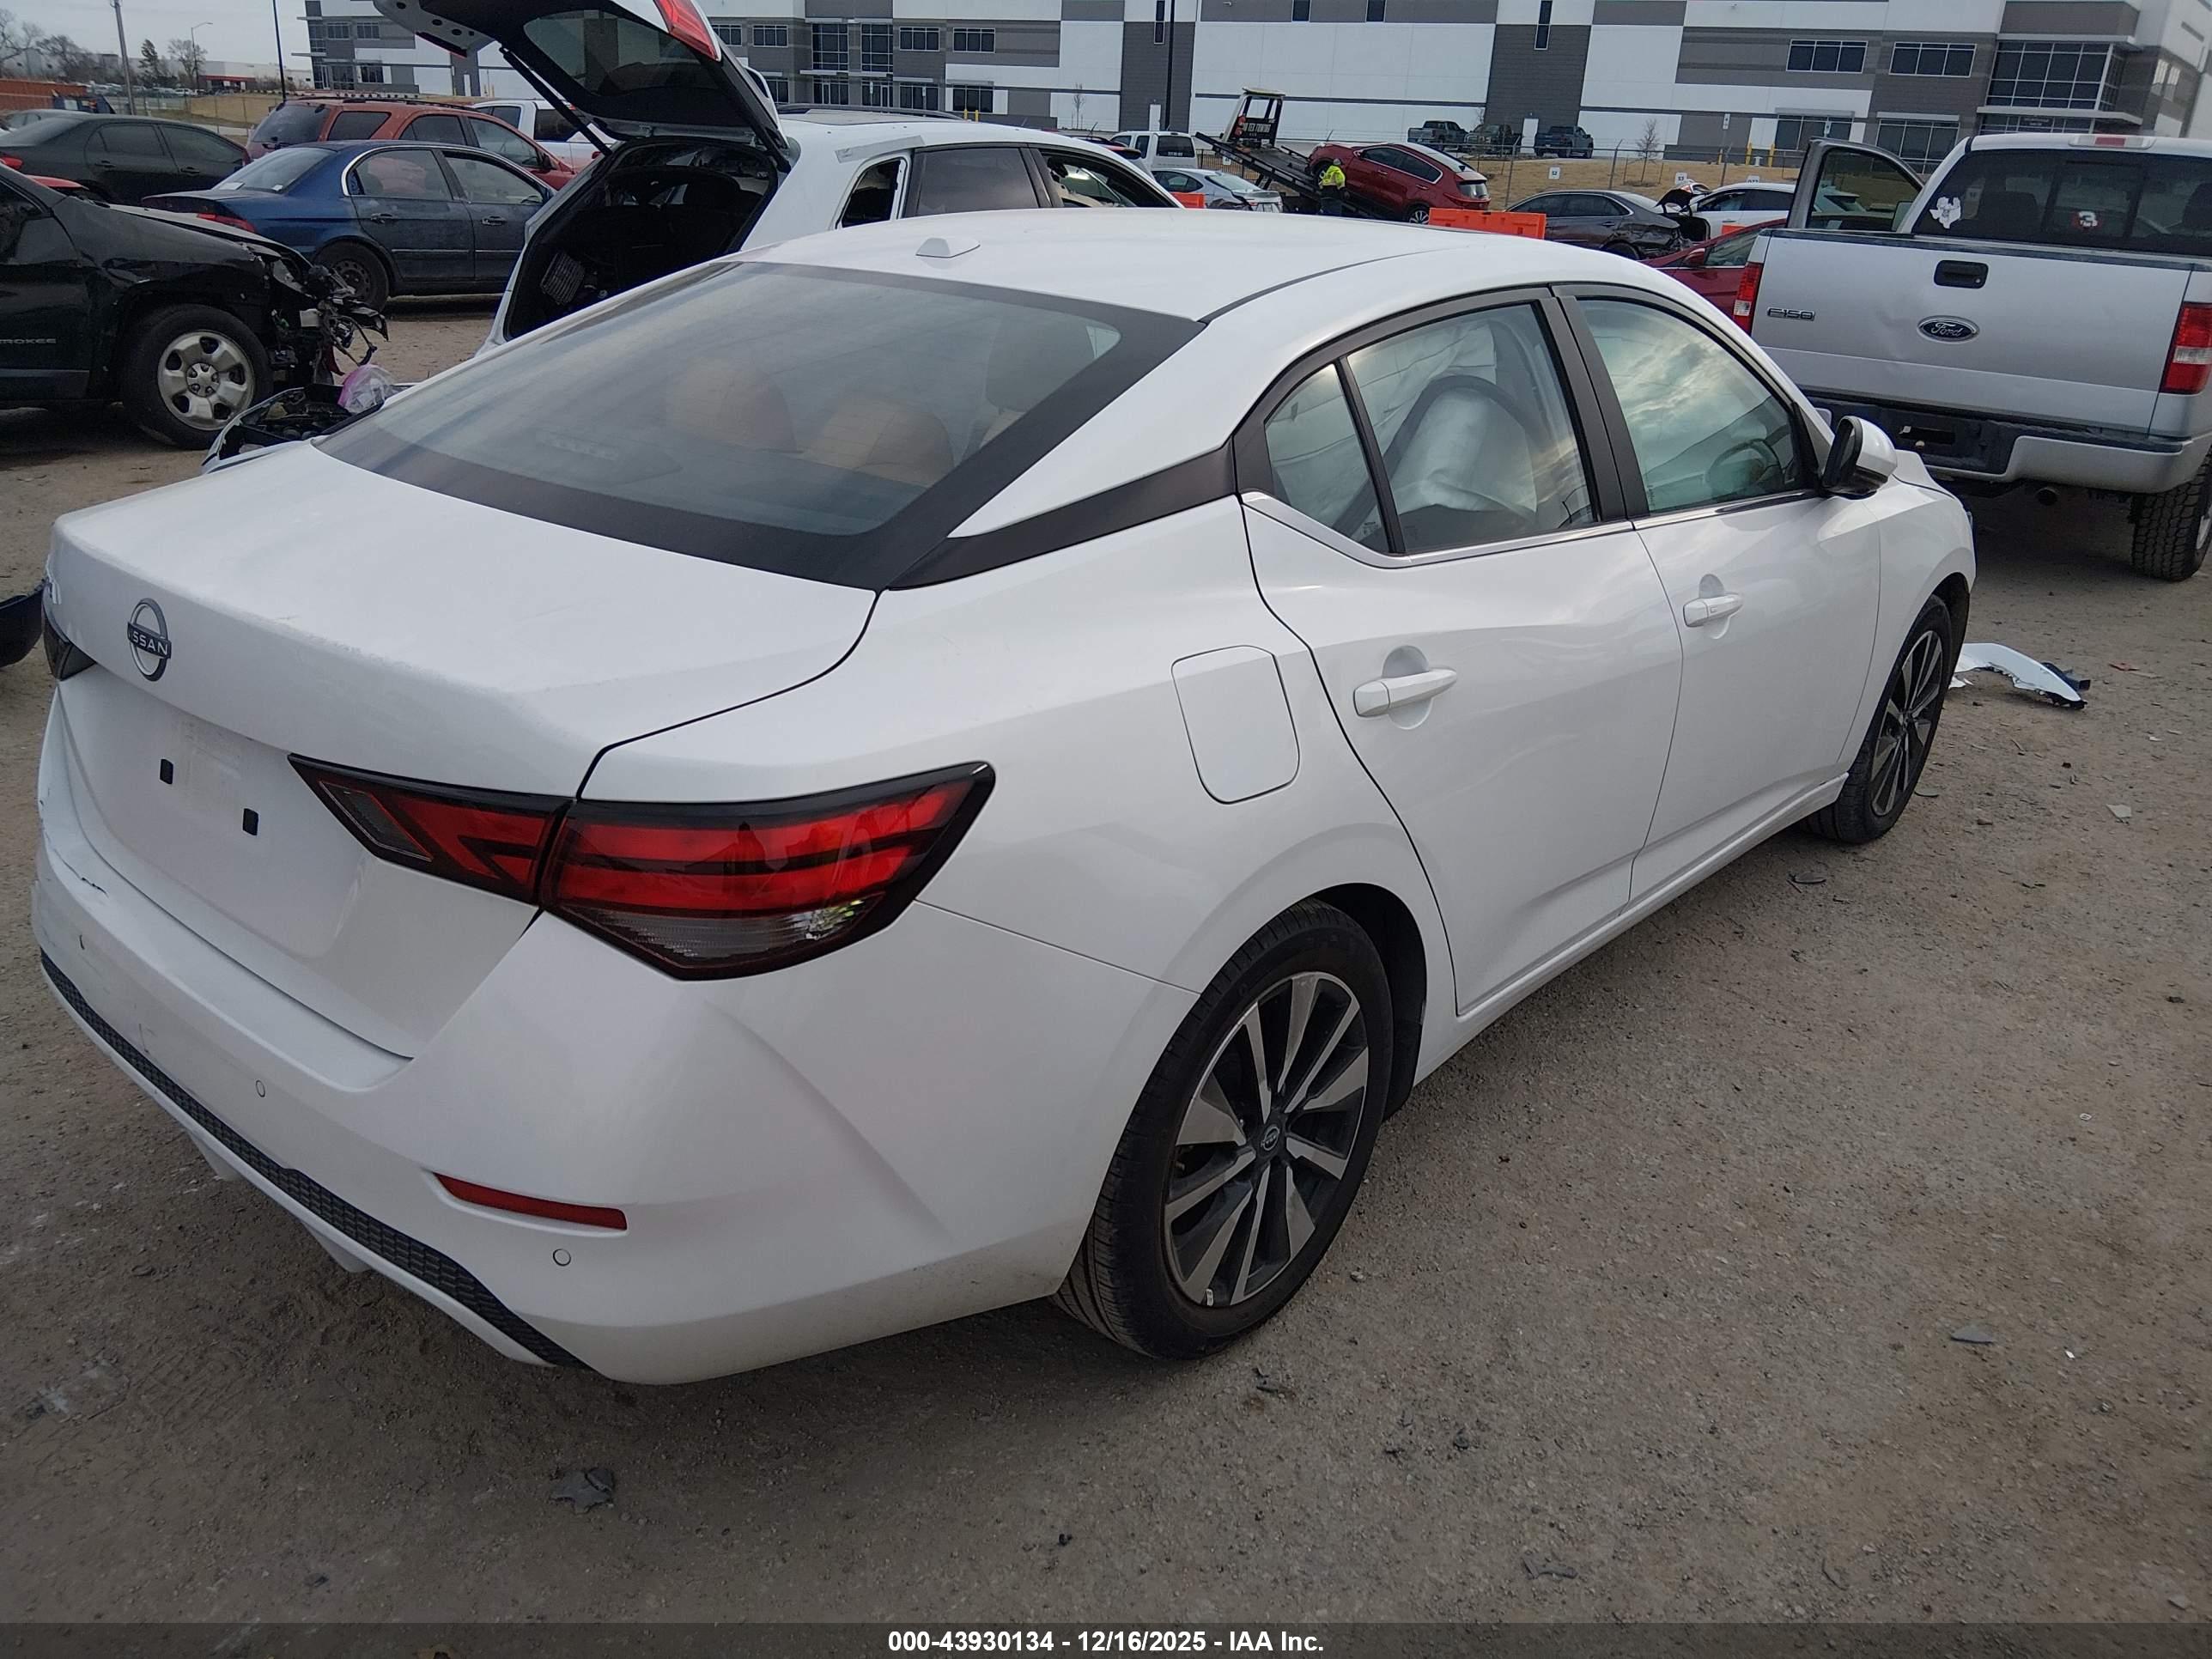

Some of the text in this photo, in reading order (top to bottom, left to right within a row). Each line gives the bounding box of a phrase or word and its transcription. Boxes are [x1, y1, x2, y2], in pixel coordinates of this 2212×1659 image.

[1767, 307, 1815, 322] F150
[1930, 322, 1965, 337] Ford
[131, 629, 169, 656] SSAN
